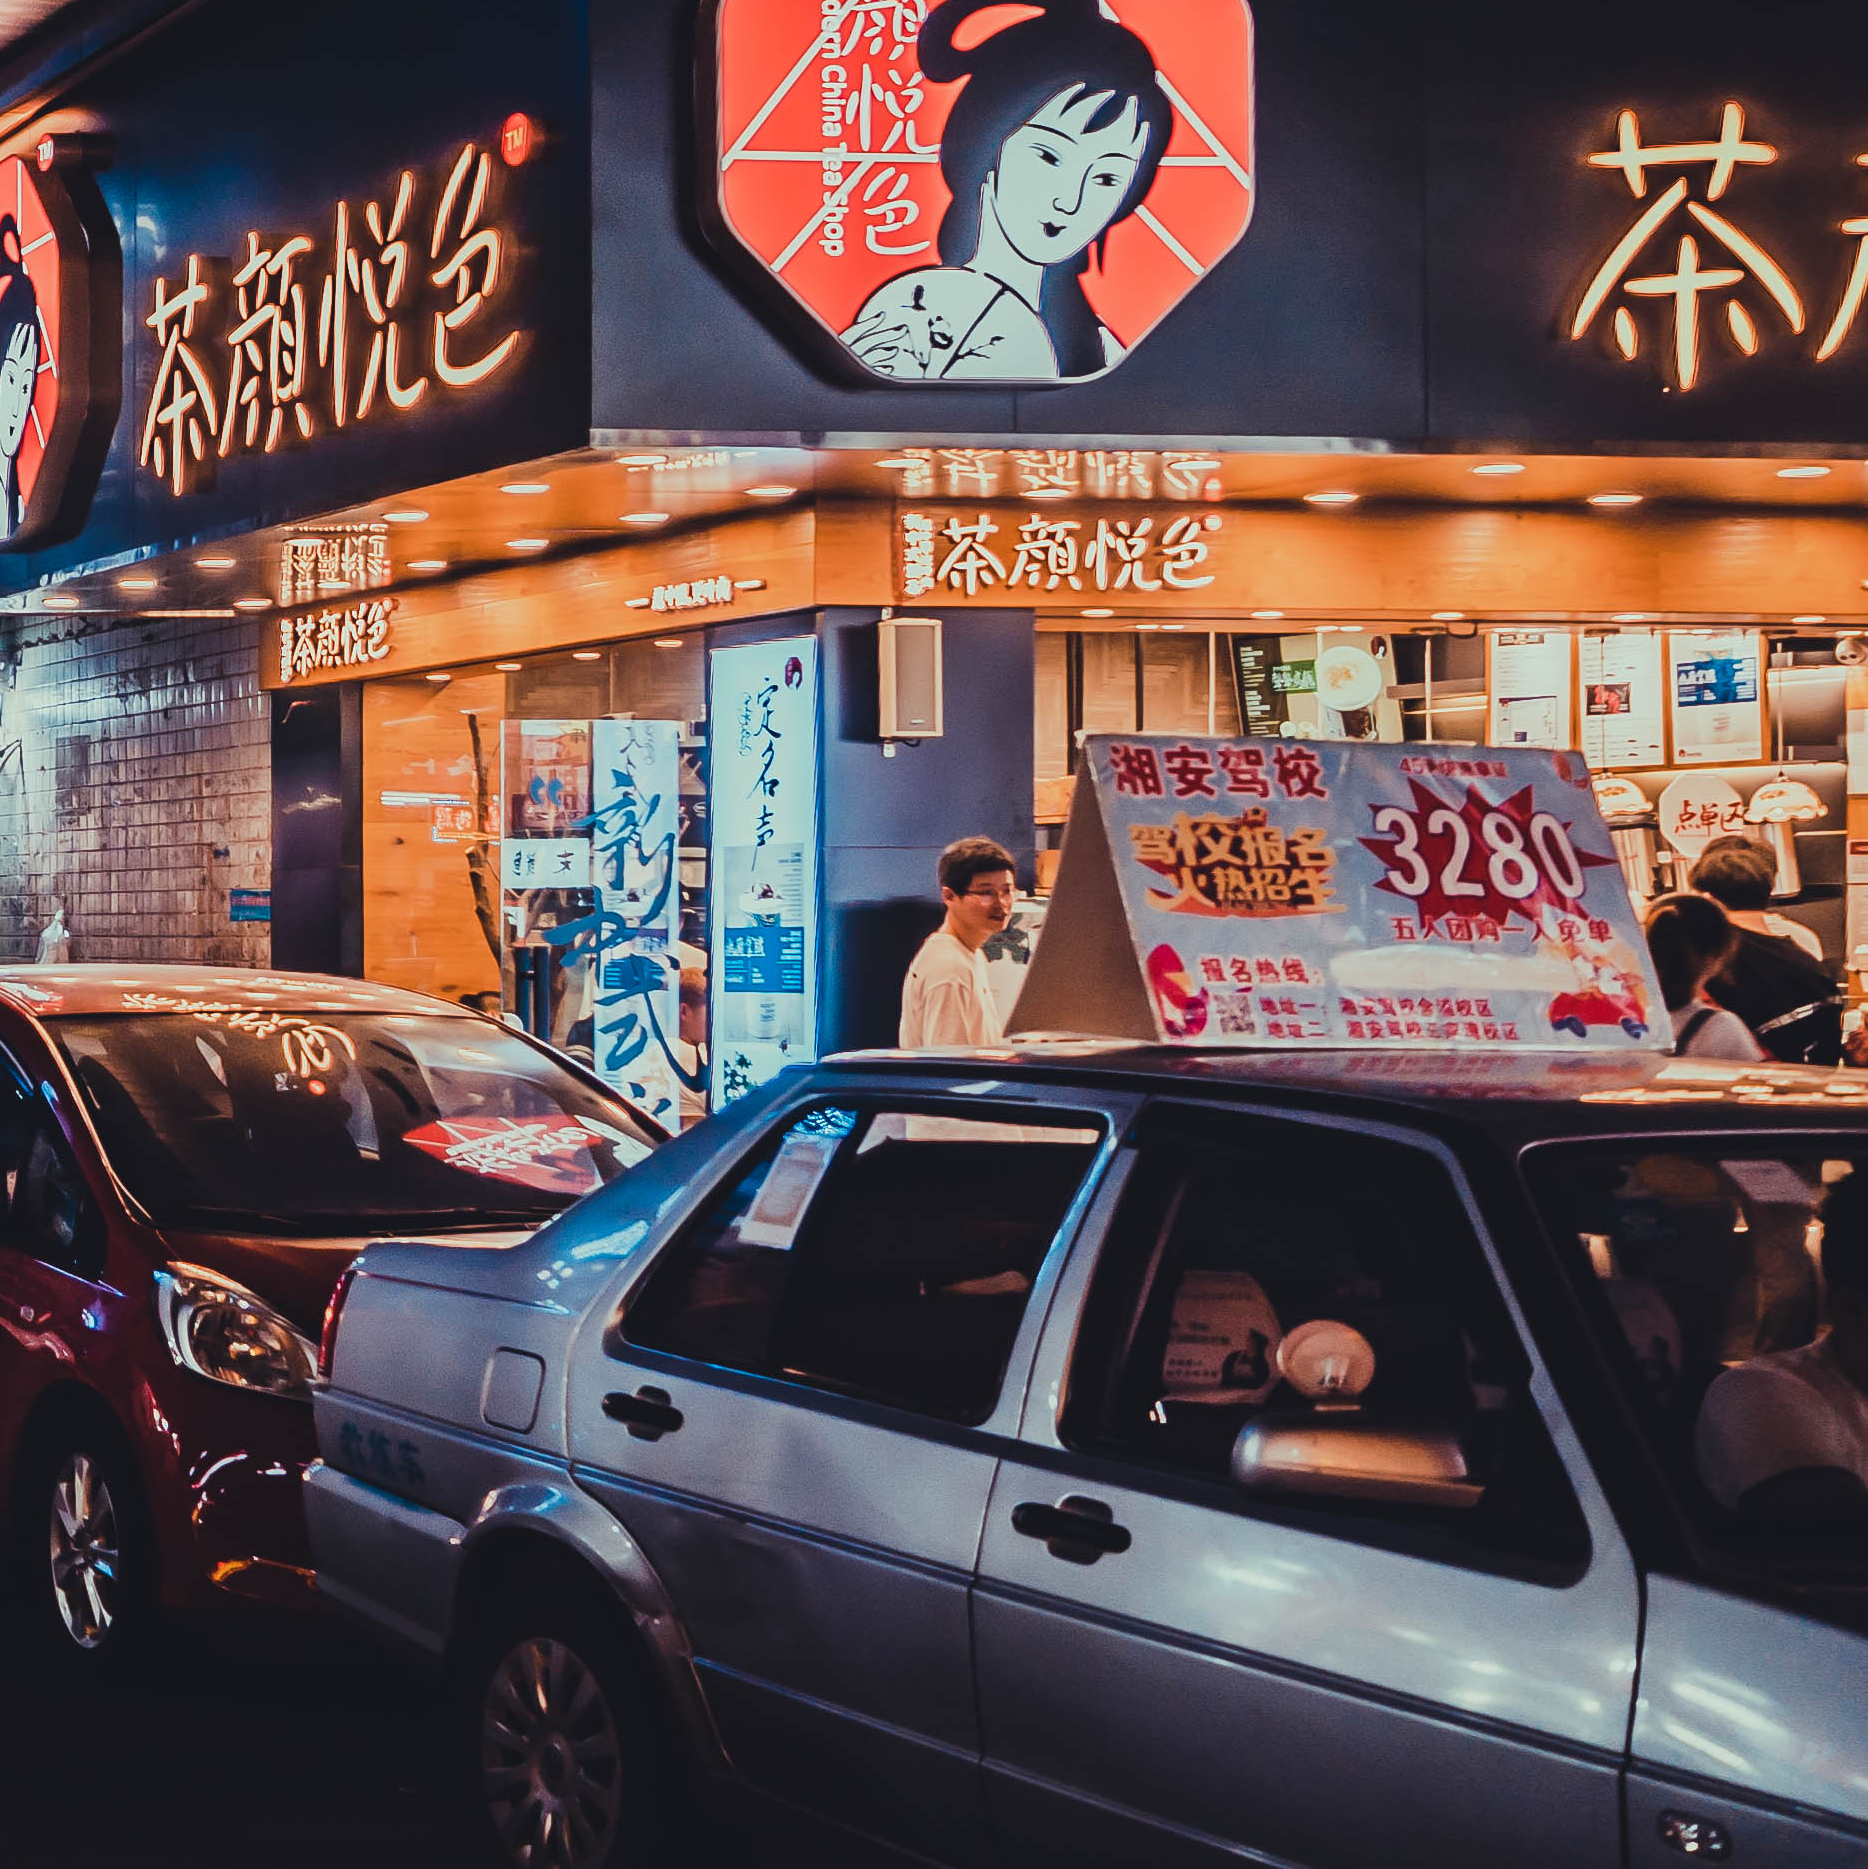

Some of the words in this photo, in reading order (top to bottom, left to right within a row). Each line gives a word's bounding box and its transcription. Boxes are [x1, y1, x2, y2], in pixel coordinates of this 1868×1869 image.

[820, 63, 848, 137] China
[141, 144, 520, 495] 茶颜悦色
[937, 513, 1216, 596] 茶颜悦色
[292, 600, 391, 678] 茶颜悦色
[1109, 744, 1329, 799] 湘安驾校
[1374, 807, 1585, 900] 3280
